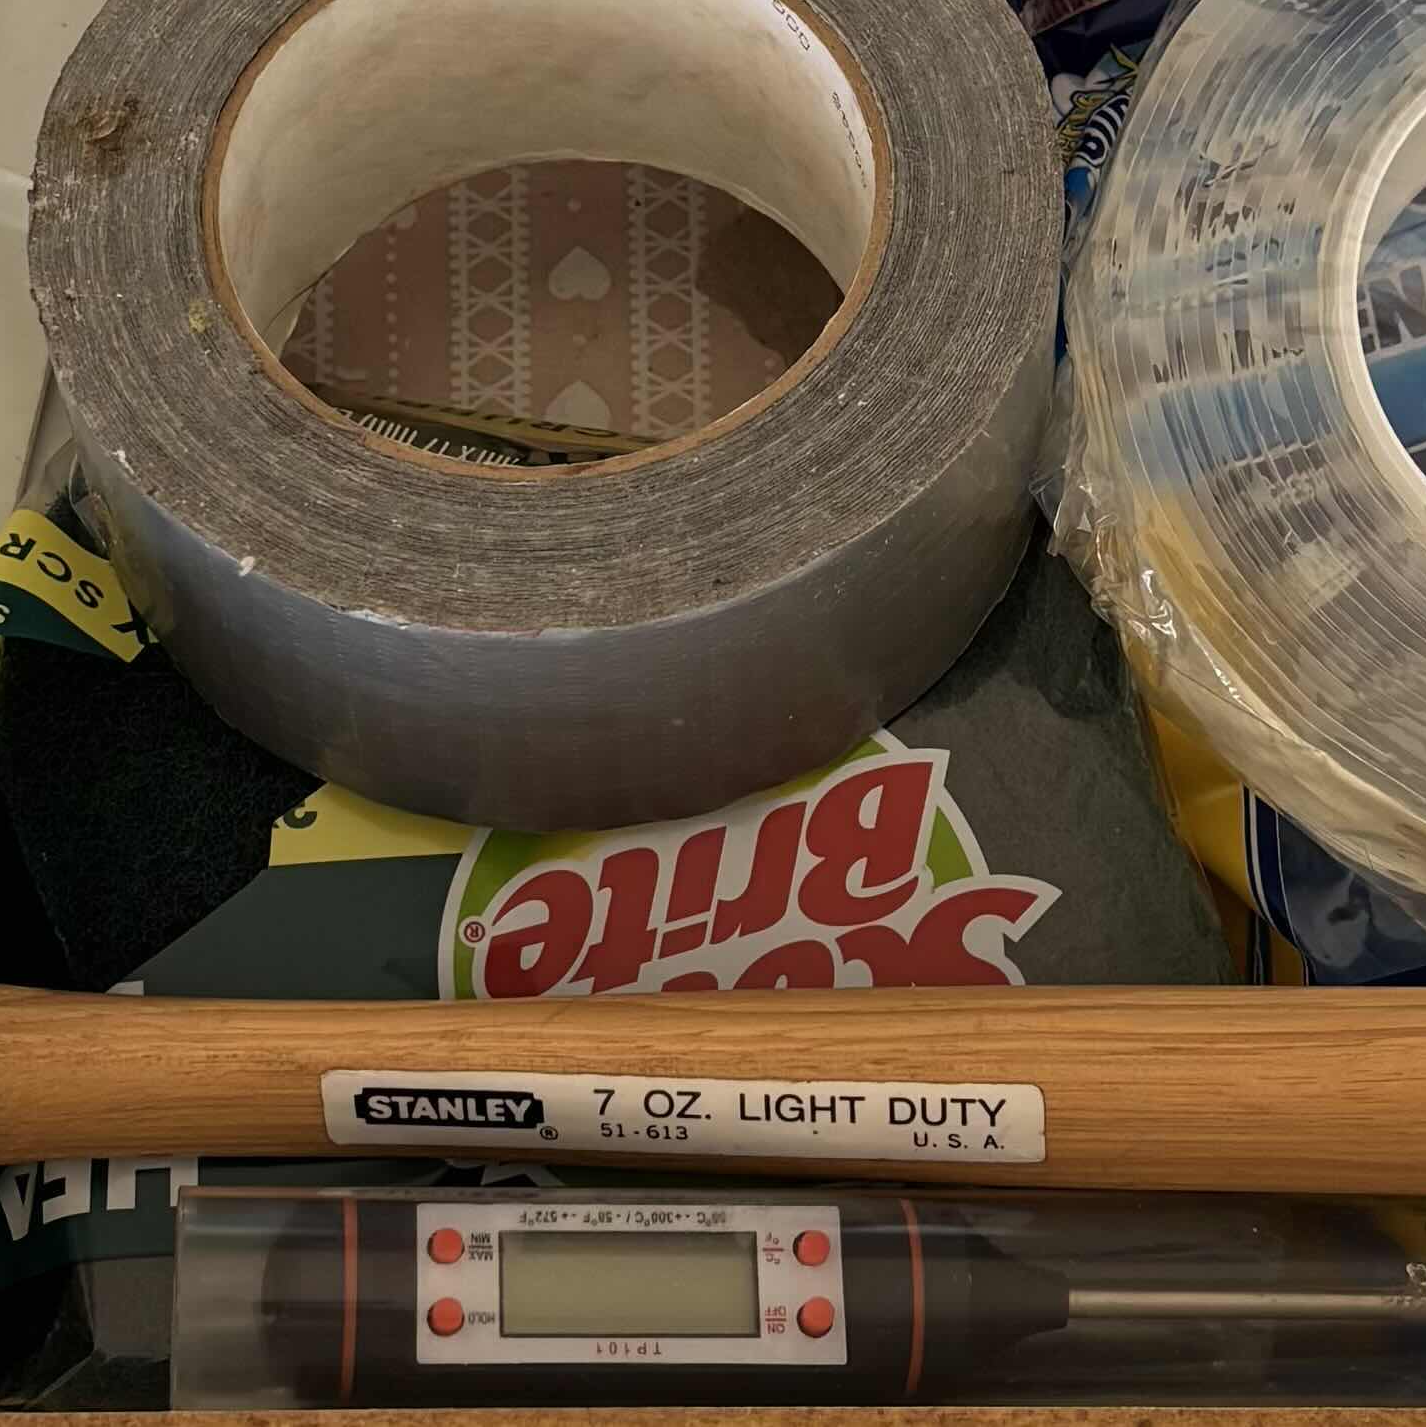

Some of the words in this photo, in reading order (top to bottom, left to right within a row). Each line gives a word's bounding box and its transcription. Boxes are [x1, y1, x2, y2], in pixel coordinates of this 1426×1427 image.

[482, 760, 935, 1001] Brite
[367, 1094, 533, 1123] STANLEY
[592, 1088, 616, 1117] 7
[642, 1088, 712, 1122] OZ.
[738, 1091, 867, 1125] LIGHT
[888, 1096, 1007, 1128] DUTY
[469, 1231, 492, 1245] MIN
[468, 1248, 494, 1261] MAX
[765, 1321, 786, 1335] ON
